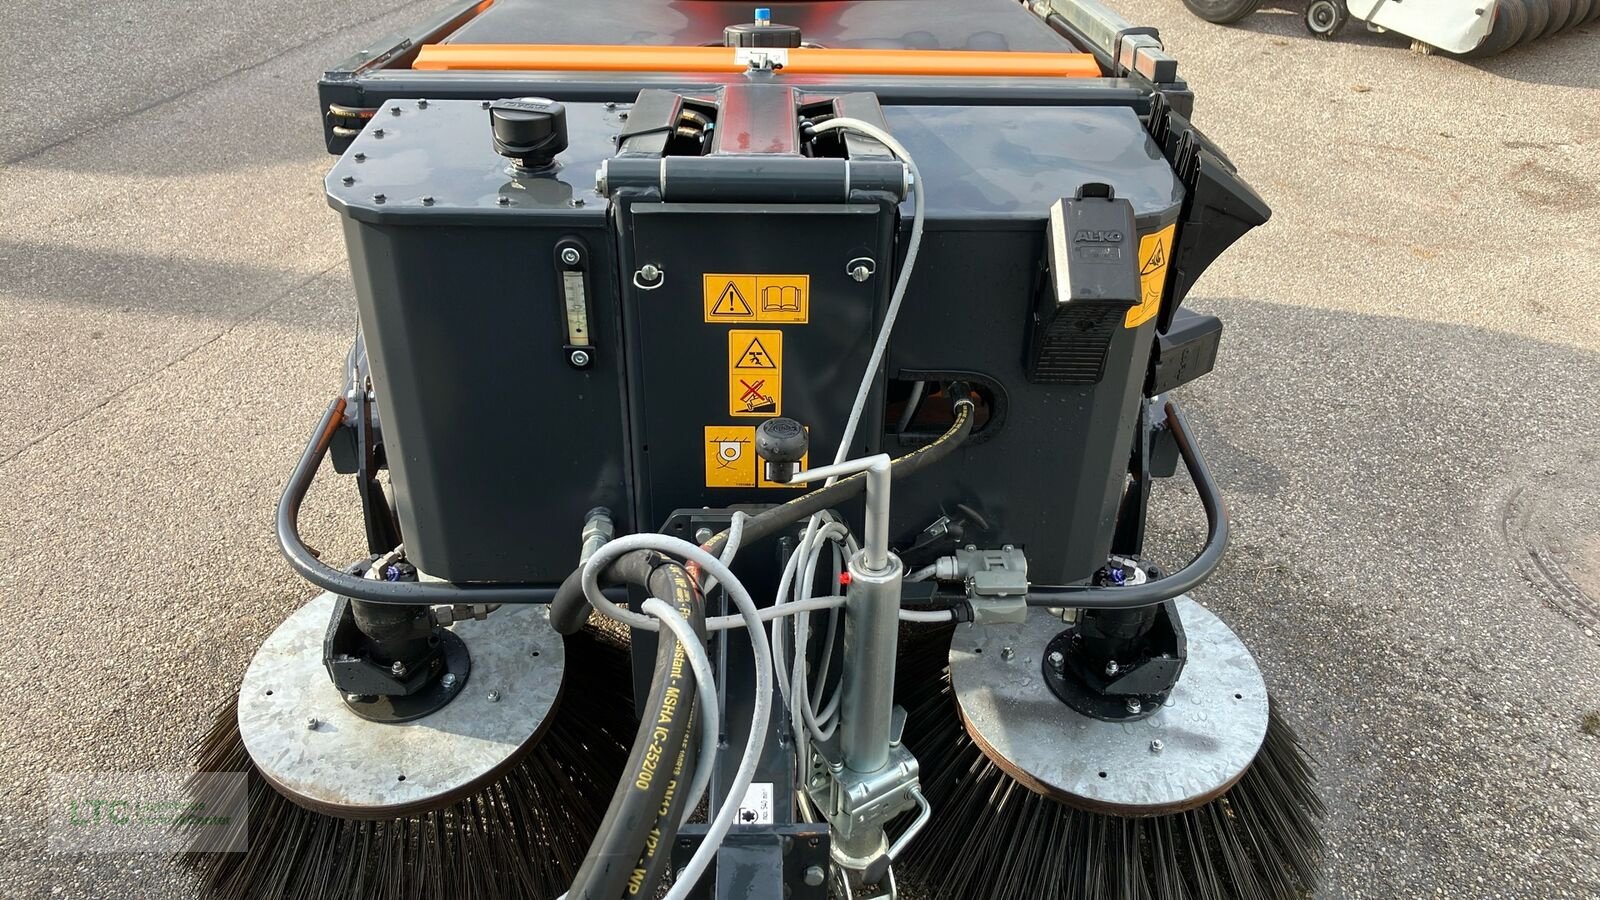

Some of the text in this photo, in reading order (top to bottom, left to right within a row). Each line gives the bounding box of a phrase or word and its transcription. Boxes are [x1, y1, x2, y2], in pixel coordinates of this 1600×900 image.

[657, 686, 681, 723] MSHA
[635, 726, 670, 791] IC-252/00
[629, 868, 647, 896] WP
